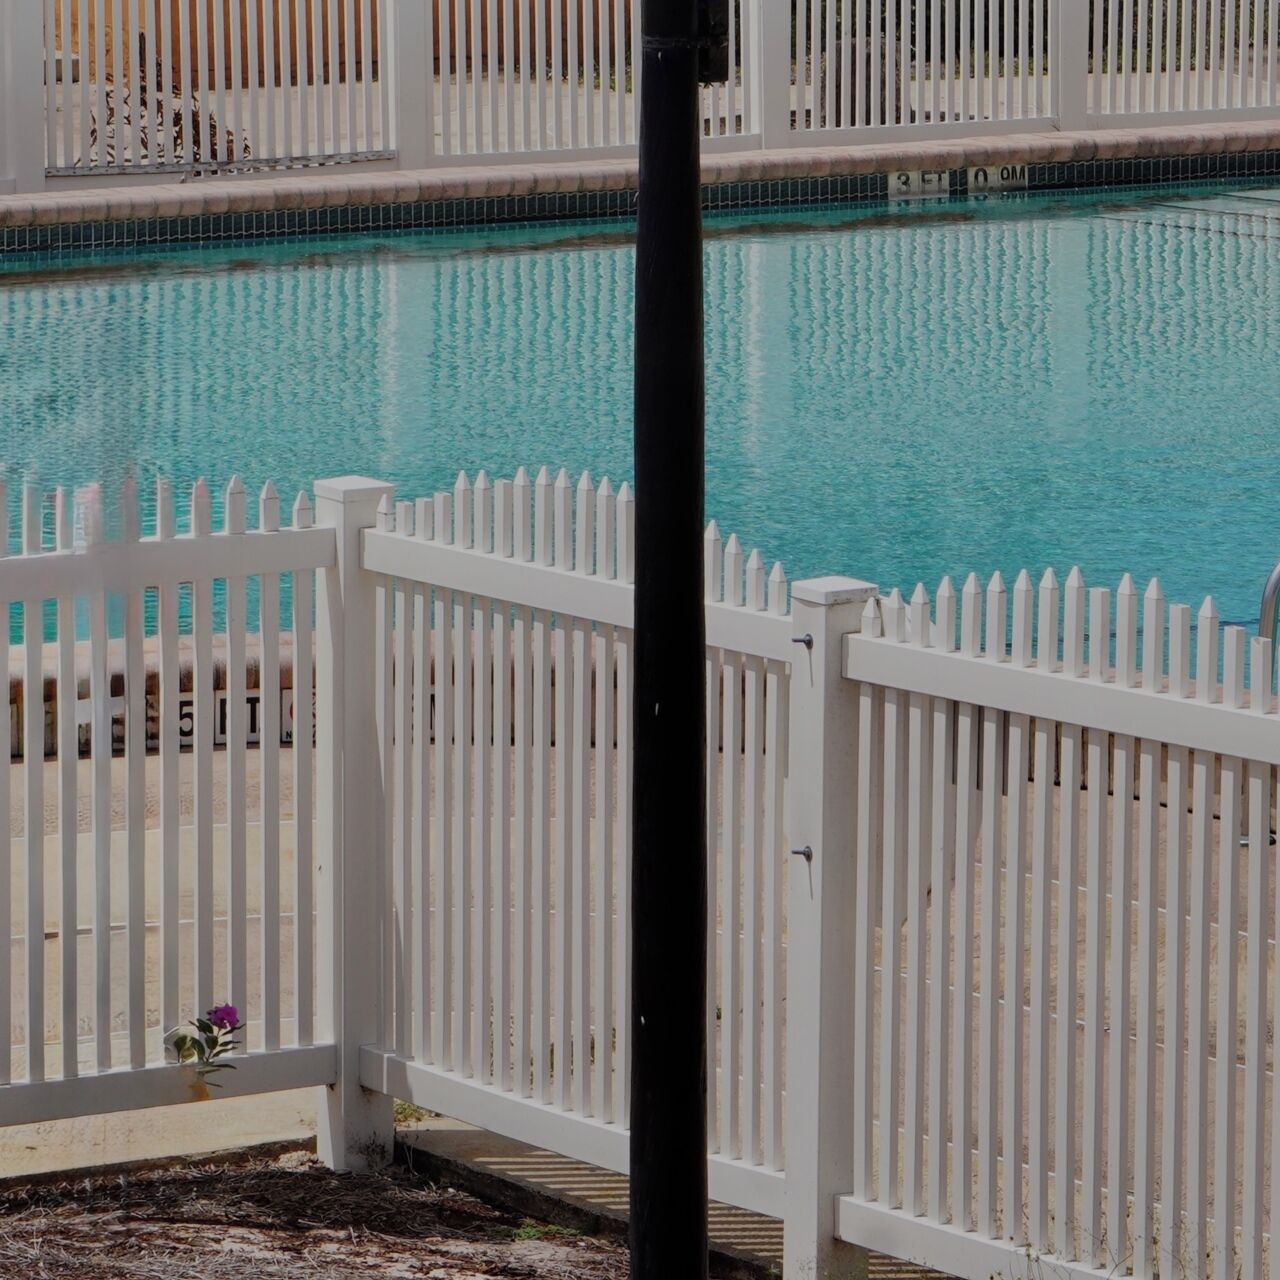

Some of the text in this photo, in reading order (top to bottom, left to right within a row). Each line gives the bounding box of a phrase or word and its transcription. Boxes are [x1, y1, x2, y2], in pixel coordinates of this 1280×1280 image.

[897, 172, 912, 195] 3
[920, 169, 947, 194] FT
[179, 700, 195, 737] 5
